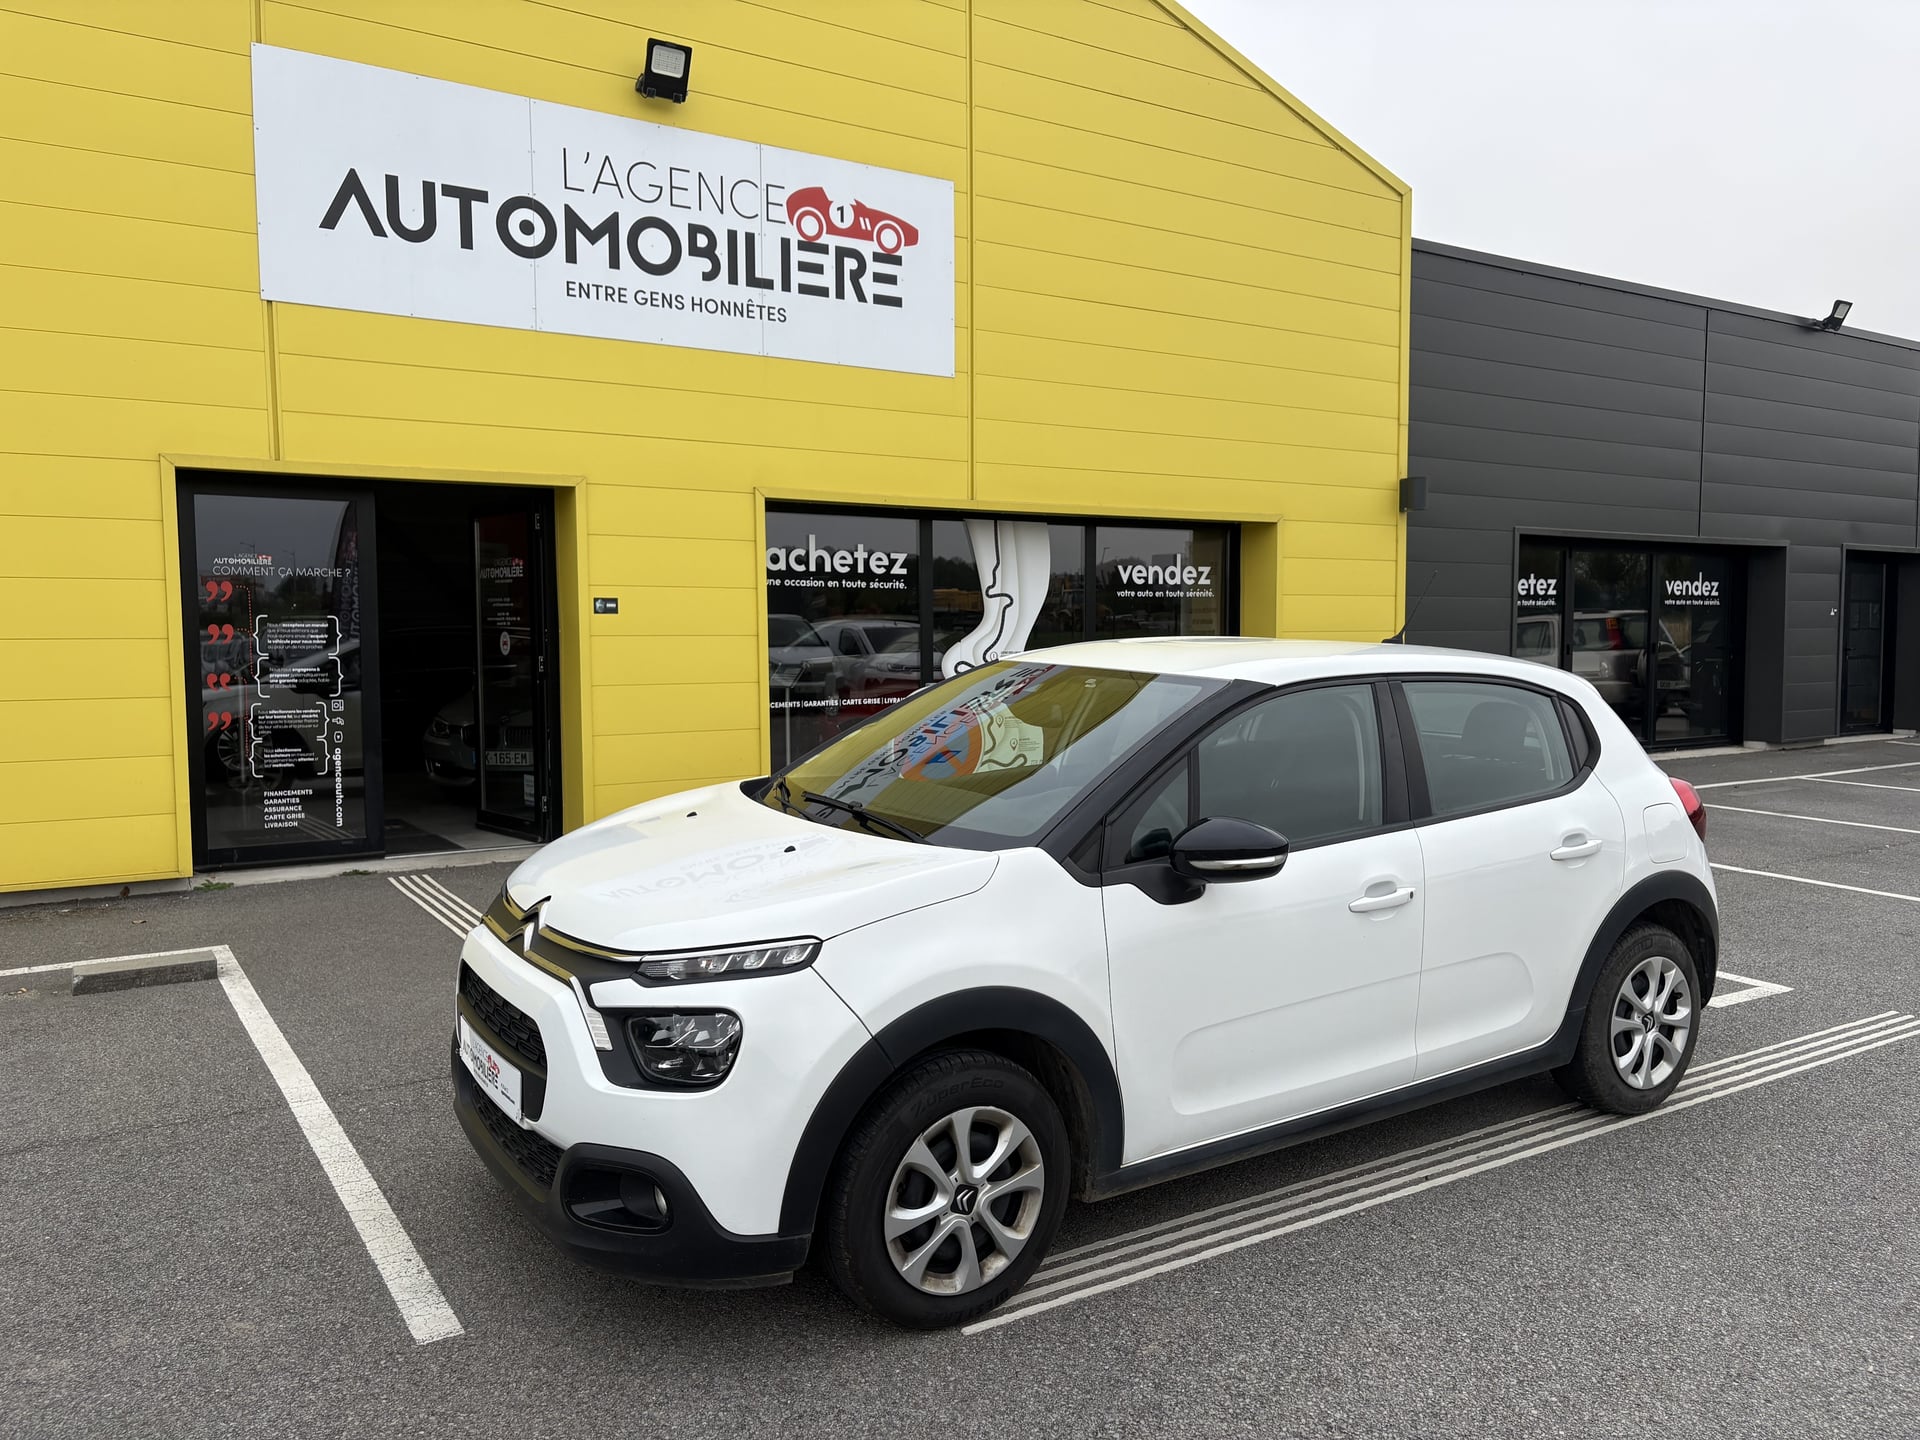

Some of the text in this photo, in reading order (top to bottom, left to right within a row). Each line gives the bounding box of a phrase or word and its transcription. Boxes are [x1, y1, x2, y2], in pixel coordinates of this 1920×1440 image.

[562, 147, 787, 225] L'AGENCE
[318, 167, 903, 308] AUTOMOBILIERE
[565, 280, 787, 324] ENTRE GENS HONNÊTES
[766, 534, 908, 575] achetez
[212, 566, 275, 577] COMMENT
[278, 567, 294, 578] ÇA
[295, 568, 342, 577] MARCHE
[1117, 553, 1212, 585] vendez
[784, 577, 825, 588] occasion
[827, 580, 840, 588] en
[842, 579, 867, 589] toute
[869, 578, 908, 590] sécurité.
[1517, 573, 1557, 596] etez
[1665, 571, 1720, 596] vendez
[1116, 588, 1215, 598] votre auto en toute sérénité.
[770, 701, 801, 709] CEMENTS
[803, 700, 839, 708] GARANTIES
[264, 788, 313, 797] FINANCEMENTS
[332, 747, 344, 827] agenceauto.com
[264, 797, 300, 805] GARANTIES
[264, 805, 302, 813] ASSURANCE
[264, 812, 305, 821] CARTE GRISE
[264, 820, 298, 829] LIVRAISON
